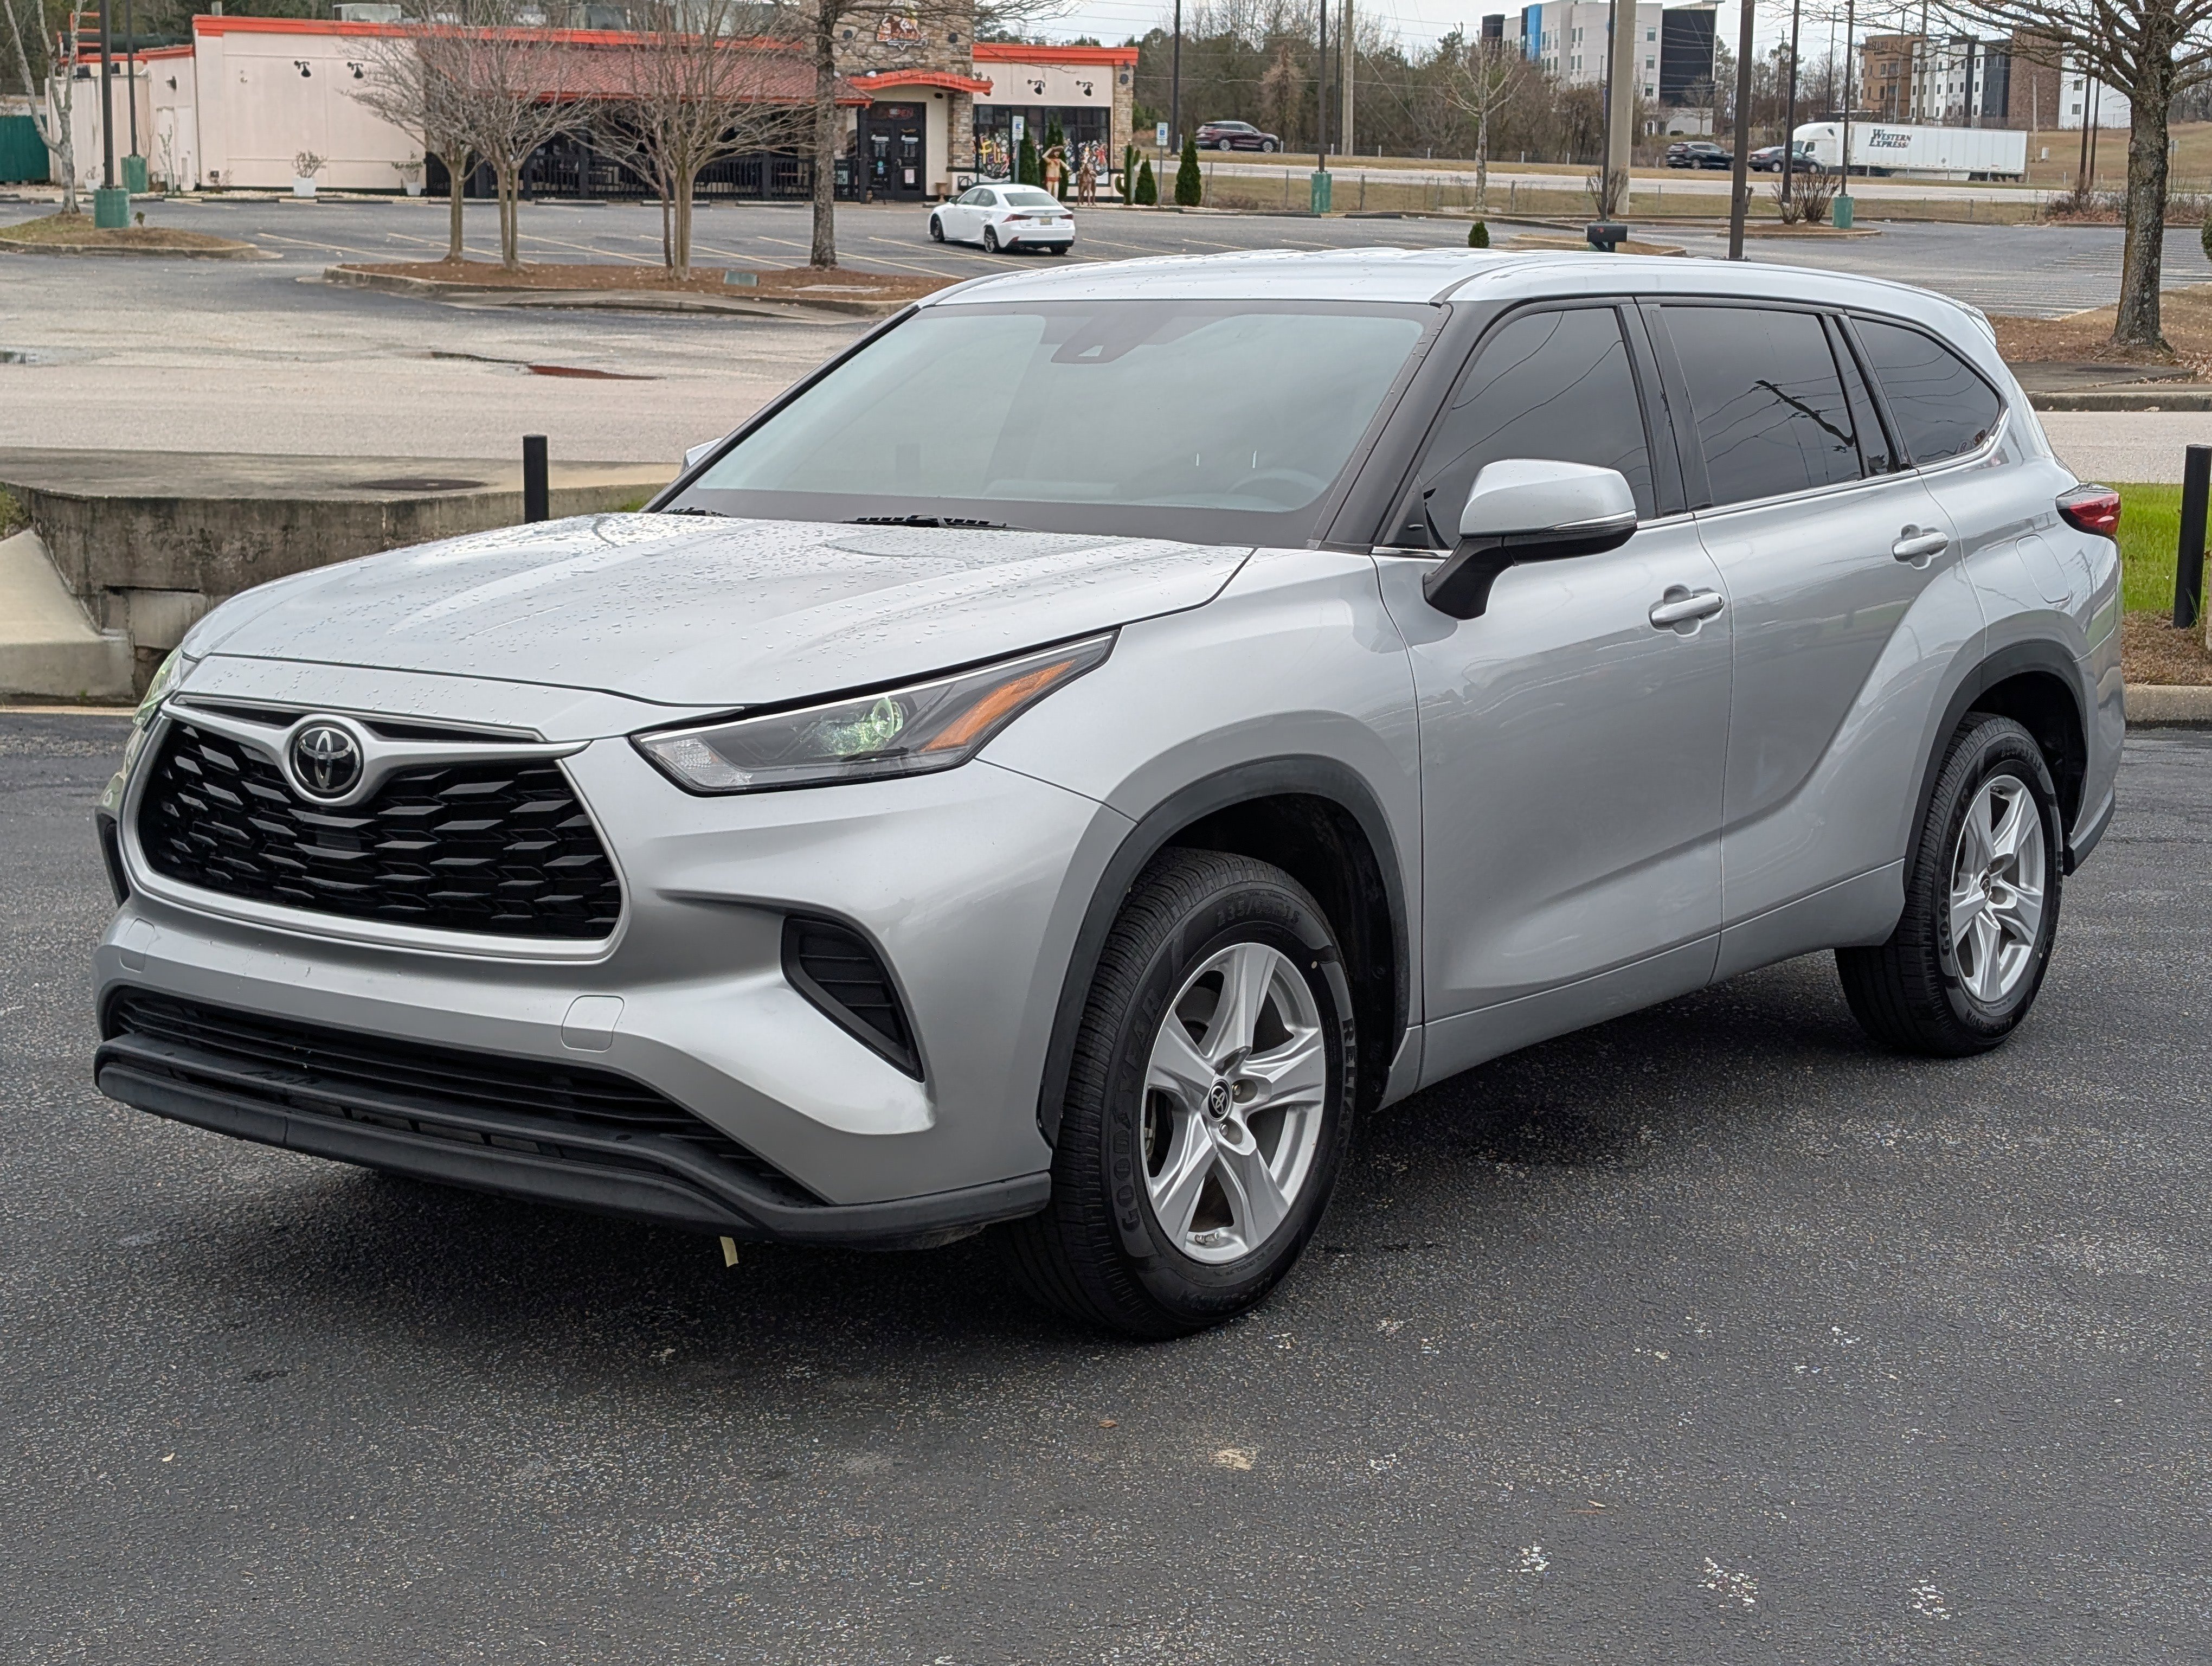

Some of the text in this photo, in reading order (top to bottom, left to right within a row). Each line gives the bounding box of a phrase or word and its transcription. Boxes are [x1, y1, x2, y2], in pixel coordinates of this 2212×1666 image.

[1873, 129, 1912, 141] WESTERN
[1869, 136, 1907, 148] EXPRESS
[979, 139, 1010, 174] Feliz
